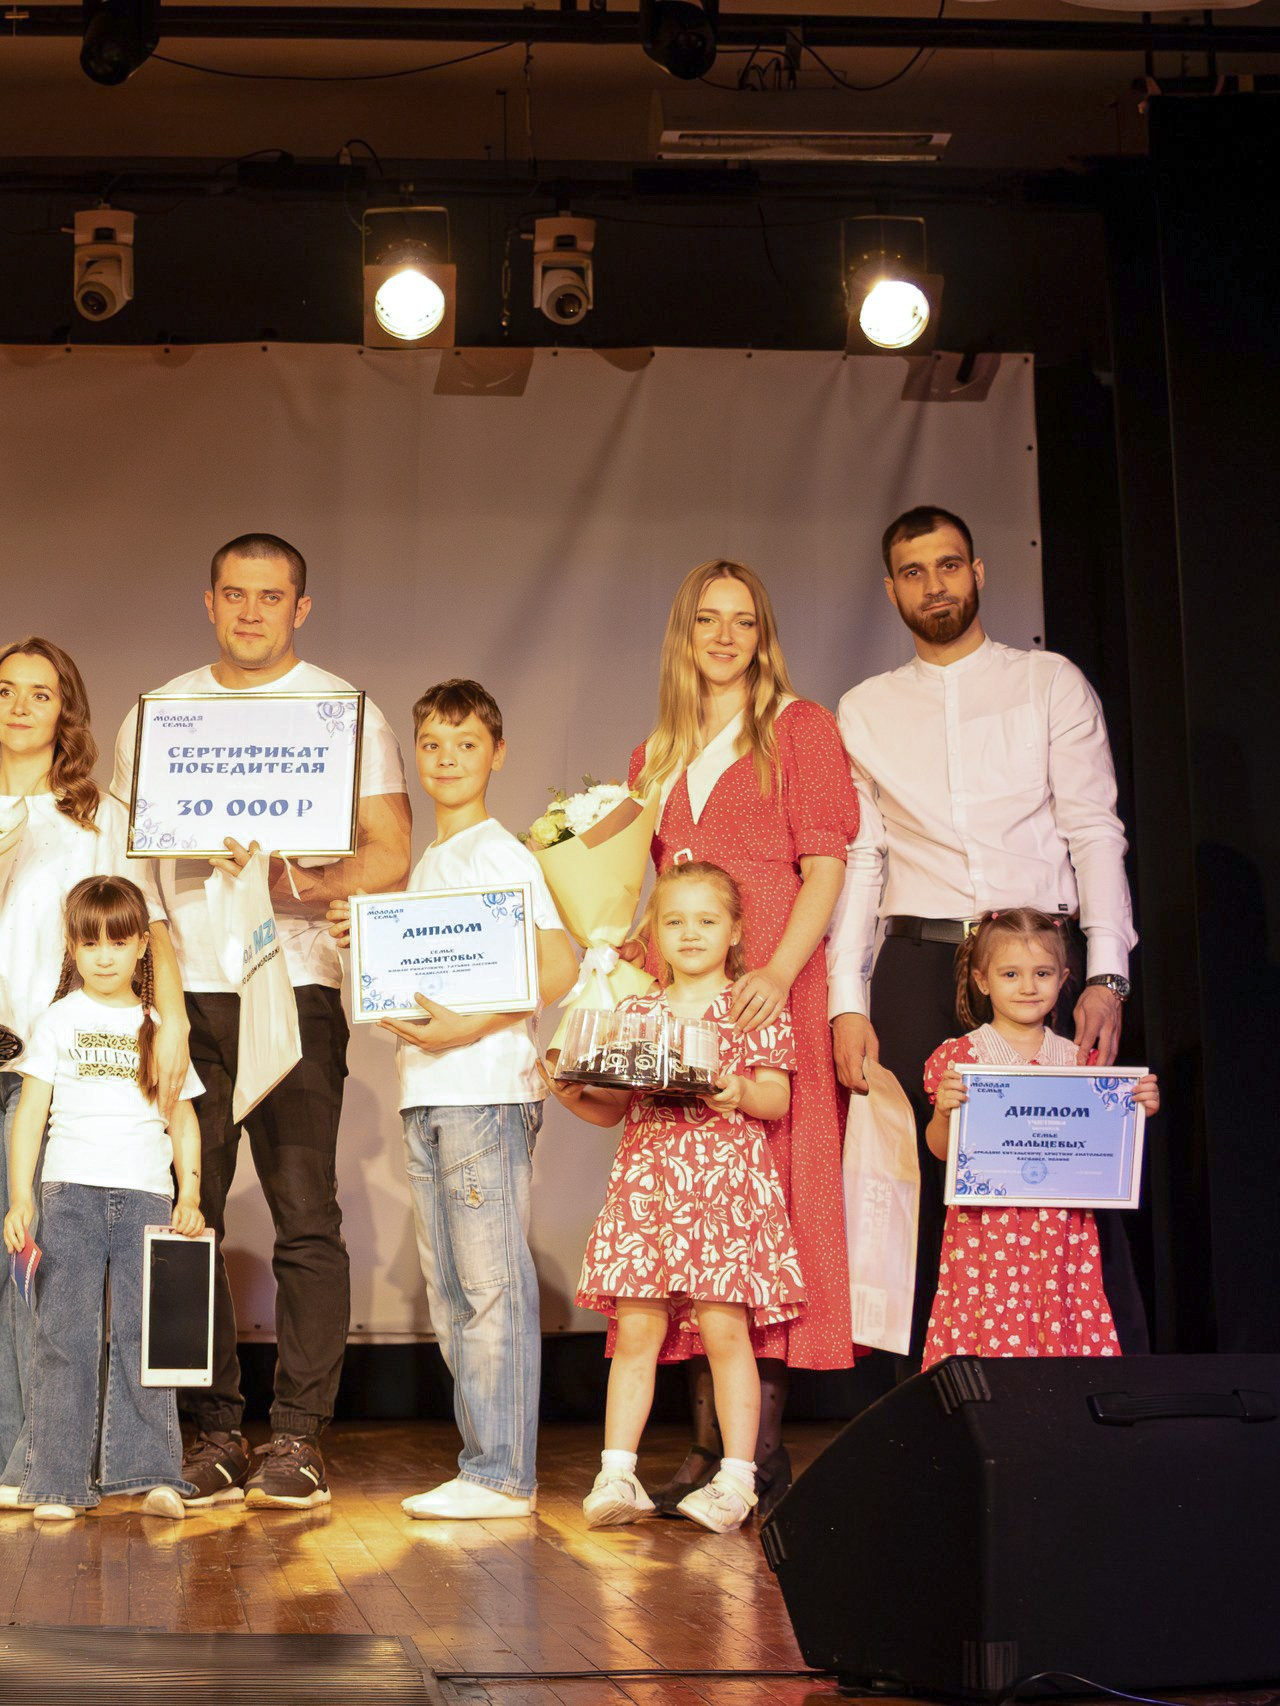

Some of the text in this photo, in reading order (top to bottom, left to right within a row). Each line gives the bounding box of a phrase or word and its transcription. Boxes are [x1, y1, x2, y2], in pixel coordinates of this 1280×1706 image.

[168, 745, 329, 759] СЕРТИФИКАТ
[169, 762, 326, 776] ПОБЕДИТЕЛЯ
[177, 799, 213, 817] 30
[226, 799, 289, 817] 000
[367, 908, 404, 916] МОЛОДАЯ
[402, 922, 483, 940] ДИПЛОМ
[400, 952, 485, 967] МАЖИТОВЫХ
[1005, 1105, 1090, 1118] ДИПЛОМ
[1002, 1139, 1087, 1150] МАЛЬЦЕВЫХ
